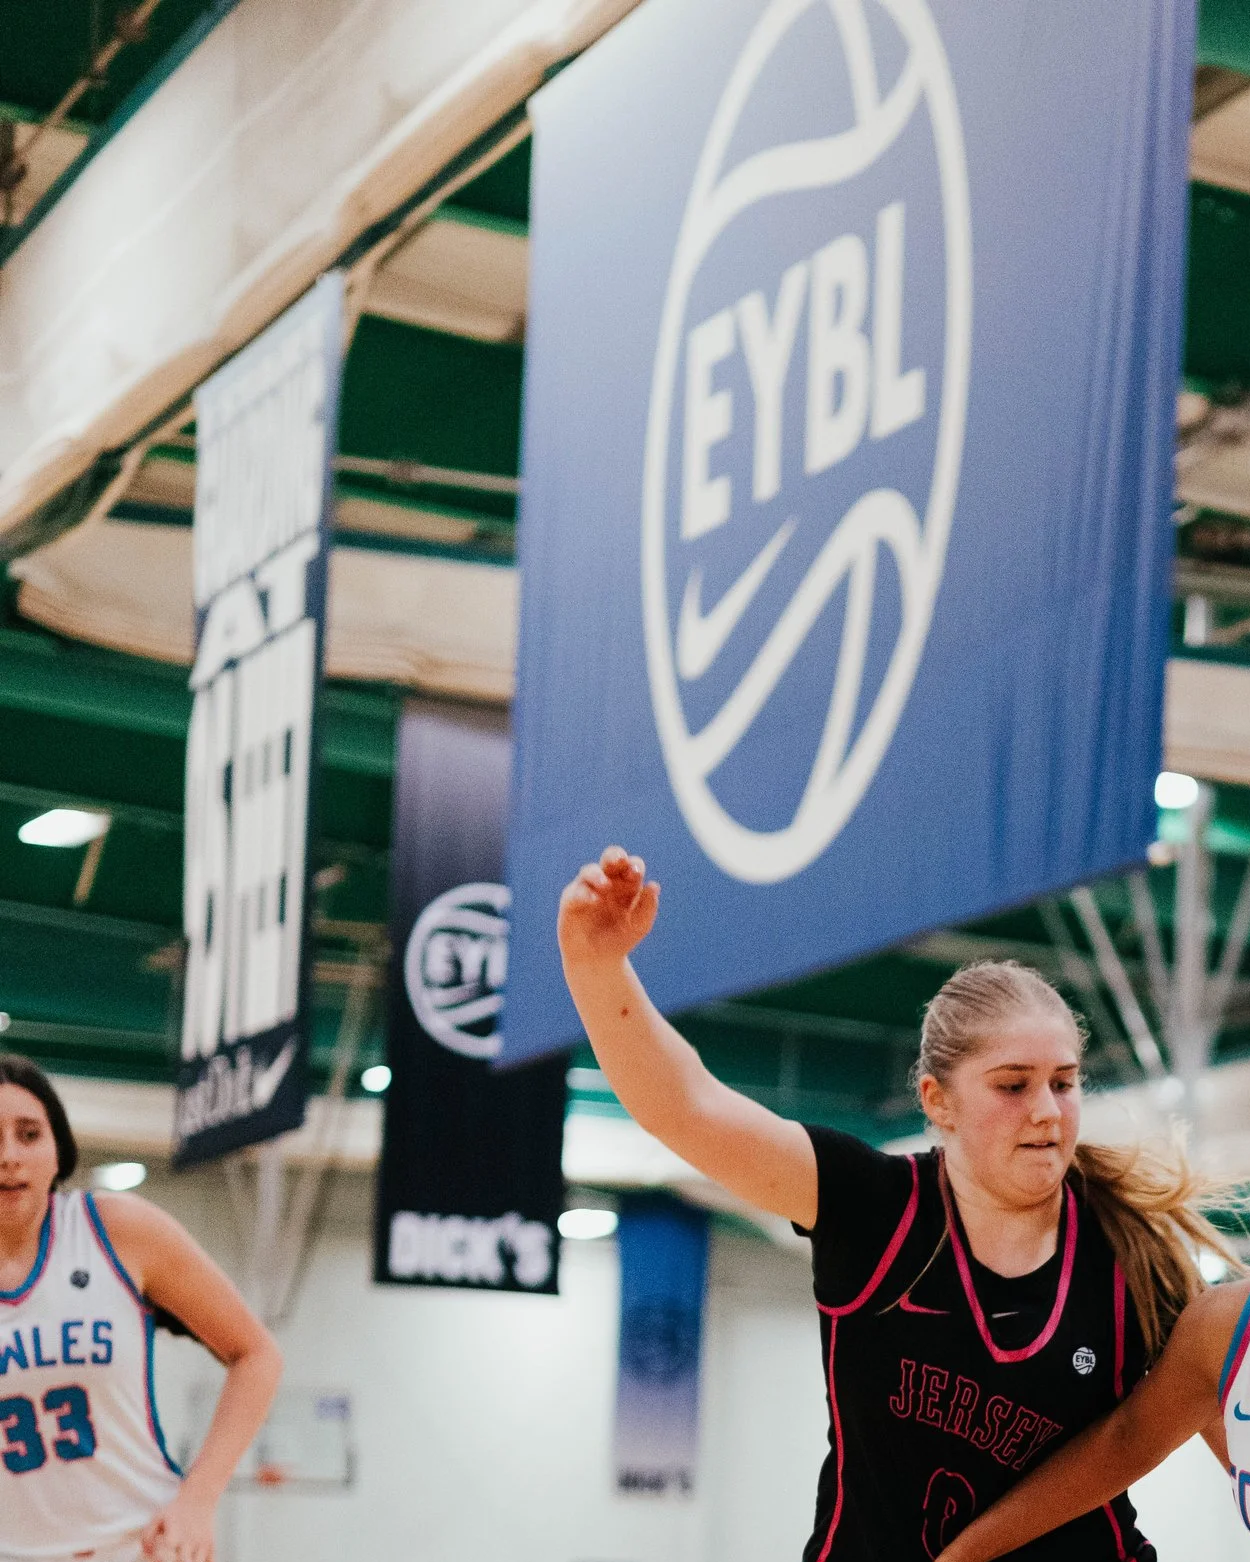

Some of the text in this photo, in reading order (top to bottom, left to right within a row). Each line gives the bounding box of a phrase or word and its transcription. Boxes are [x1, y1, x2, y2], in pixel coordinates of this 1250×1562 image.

[680, 200, 927, 542] EYBL
[387, 1209, 553, 1288] DICK'S
[1075, 1354, 1095, 1366] EYBL
[0, 1384, 97, 1475] 33
[888, 1357, 1064, 1471] JERSEY
